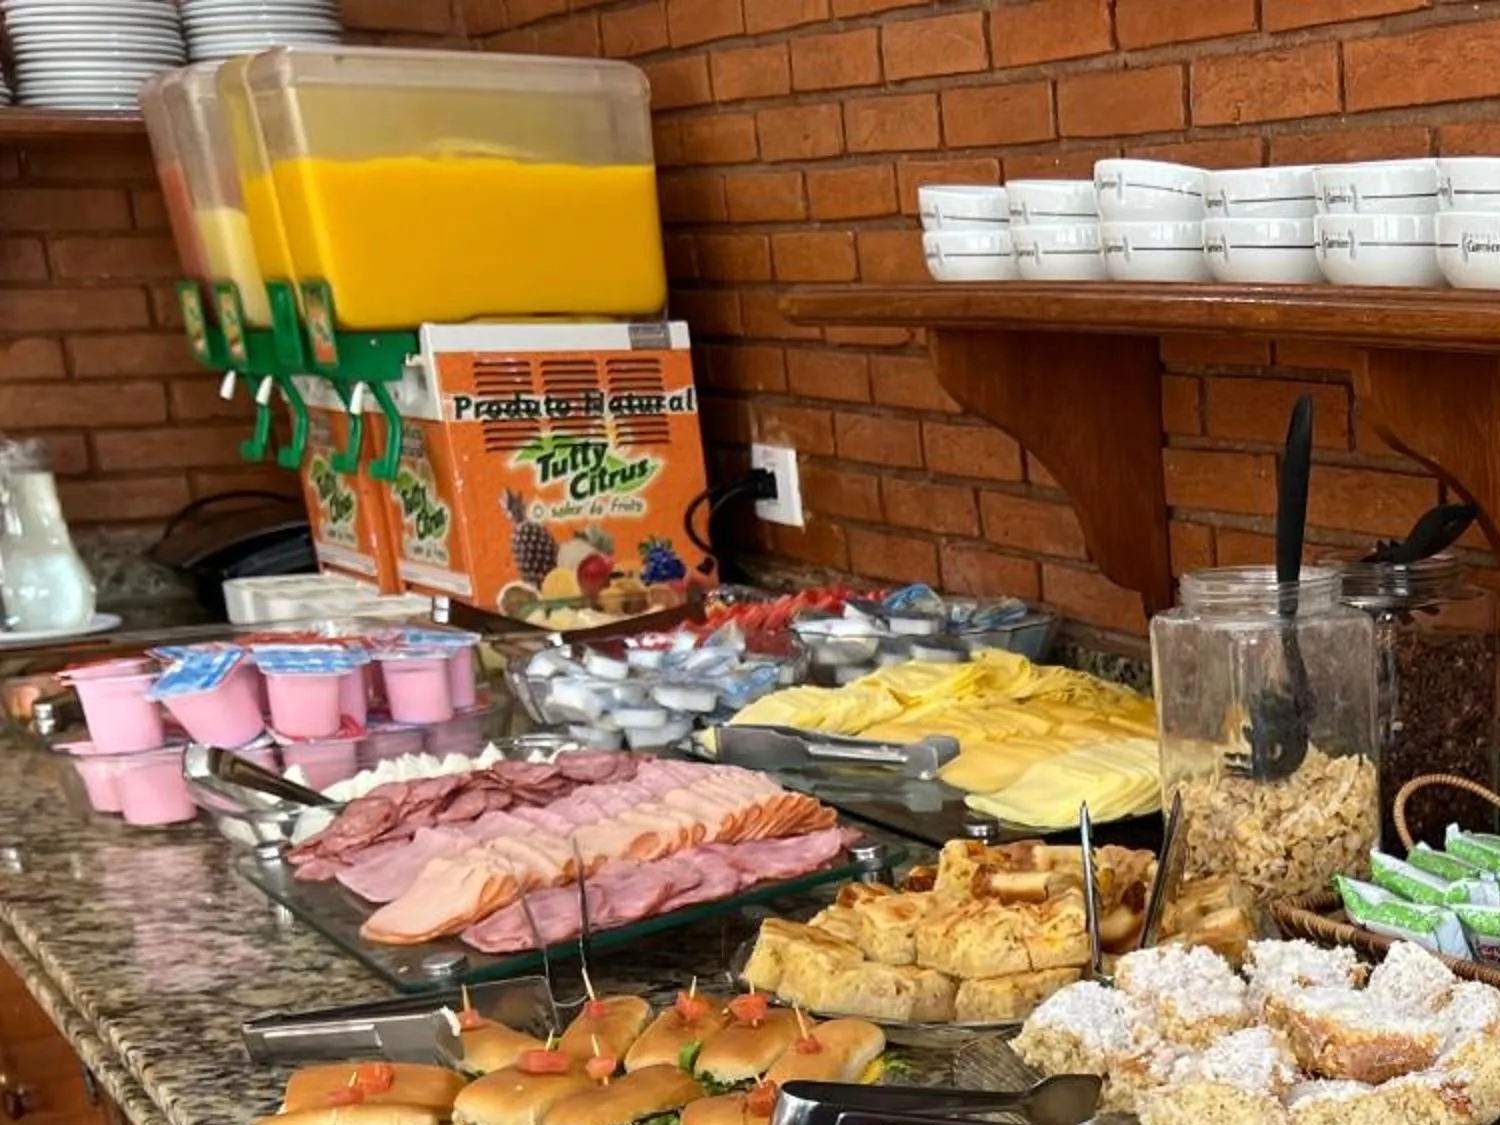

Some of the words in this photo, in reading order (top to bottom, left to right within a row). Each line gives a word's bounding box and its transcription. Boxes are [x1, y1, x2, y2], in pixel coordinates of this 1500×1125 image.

[455, 391, 571, 419] Produto
[585, 387, 695, 413] Natural
[537, 442, 608, 482] Tutty
[569, 459, 650, 500] Citrus
